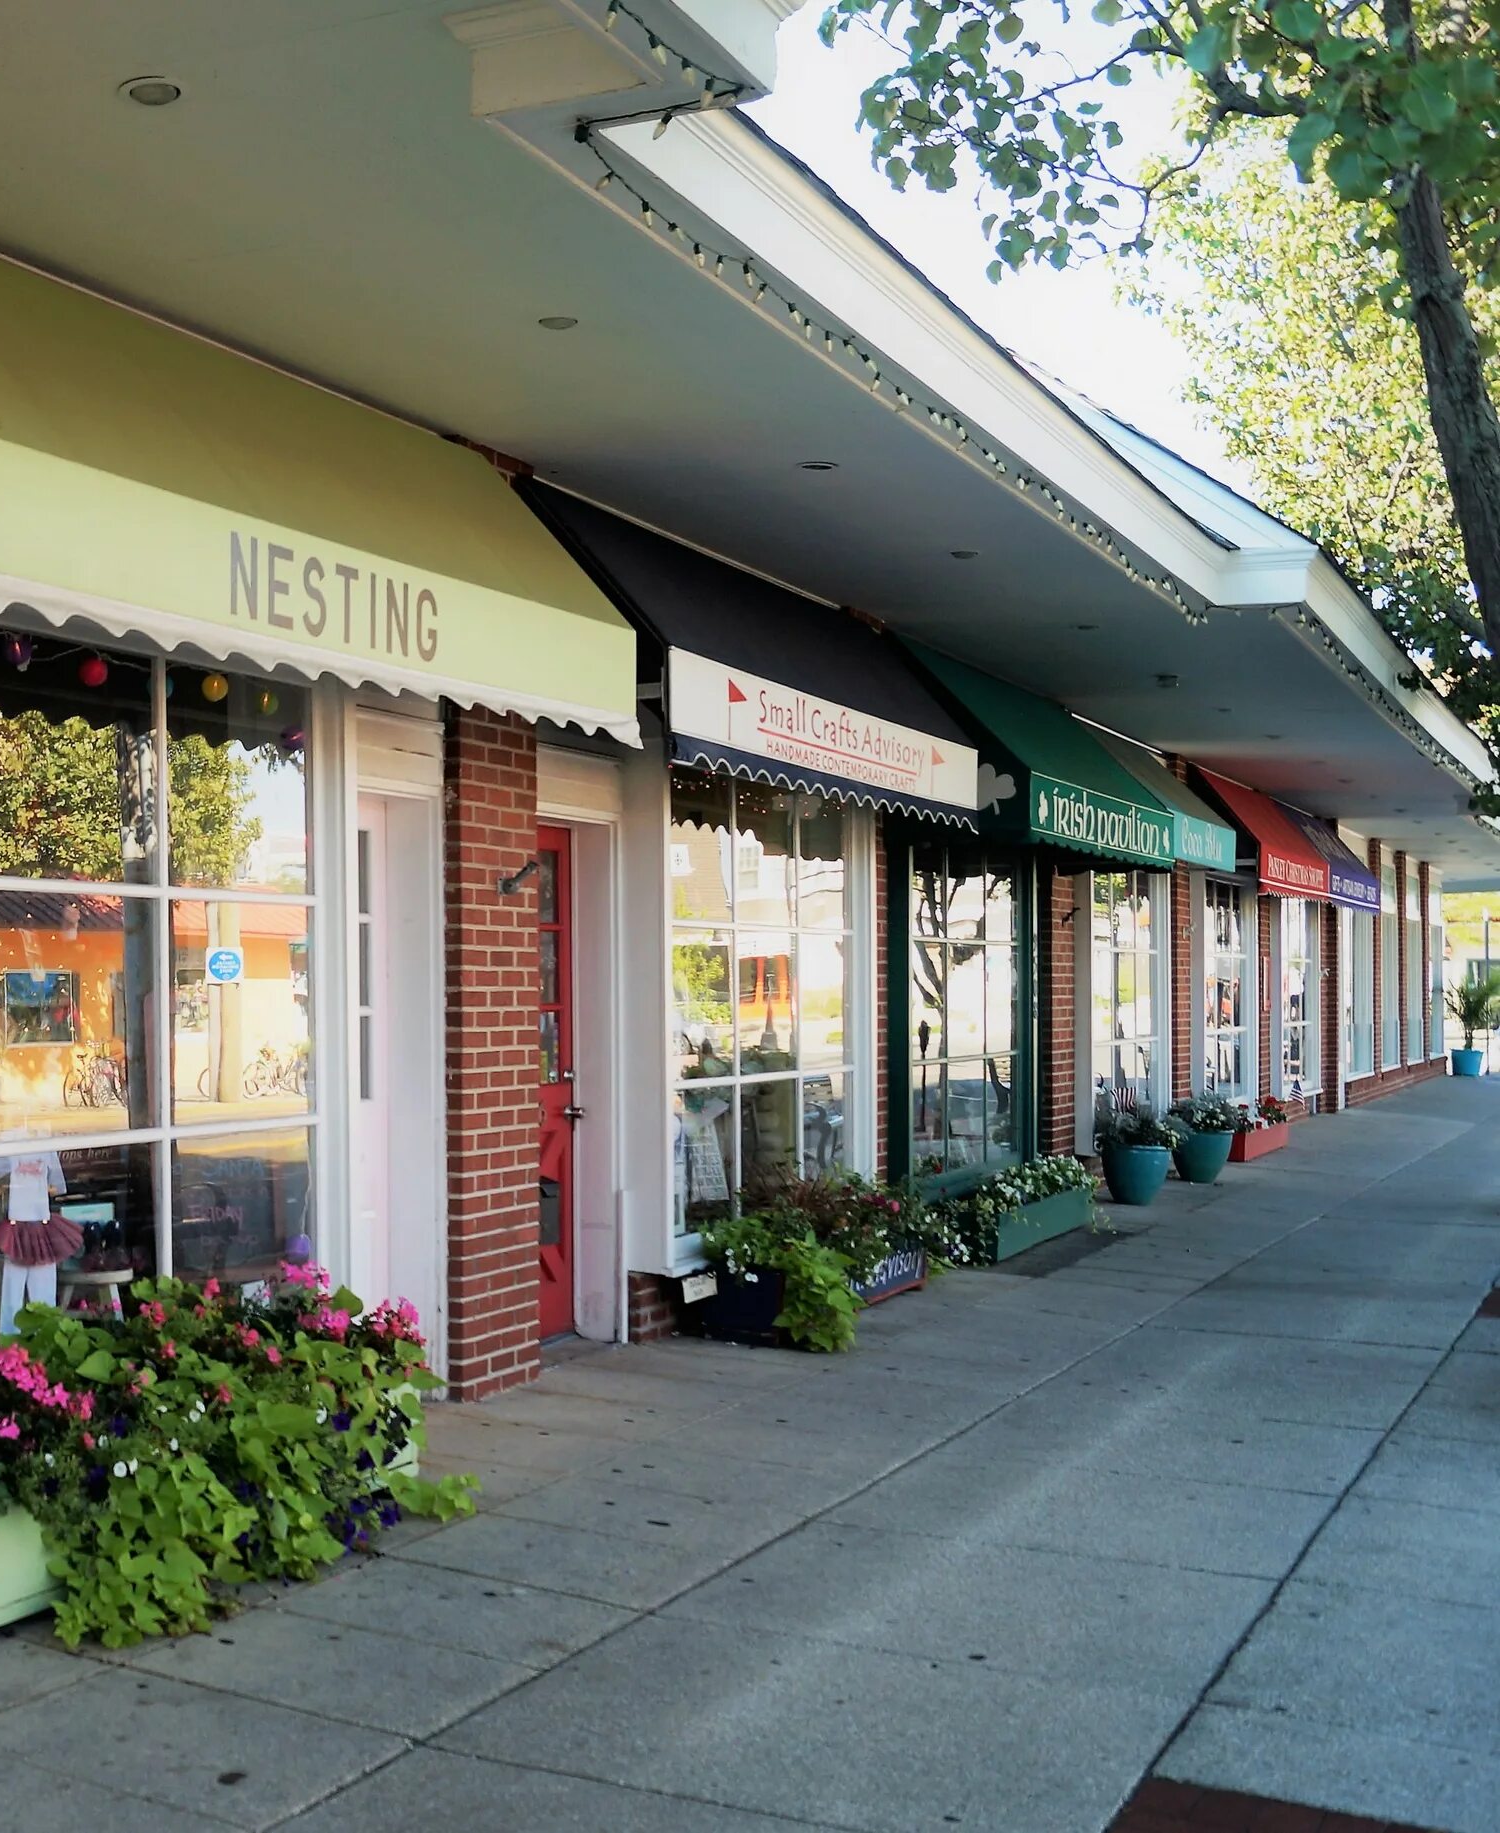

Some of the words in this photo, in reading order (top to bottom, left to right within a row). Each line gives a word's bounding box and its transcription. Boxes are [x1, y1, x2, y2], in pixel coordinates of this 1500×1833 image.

[230, 531, 438, 662] NESTING
[759, 690, 806, 733] Small
[811, 709, 858, 750] Crafts
[861, 725, 925, 776] Advisory
[766, 739, 820, 767] HANDMADE
[822, 755, 888, 785] CONTEMPORARY
[890, 773, 917, 792] CRAFTS
